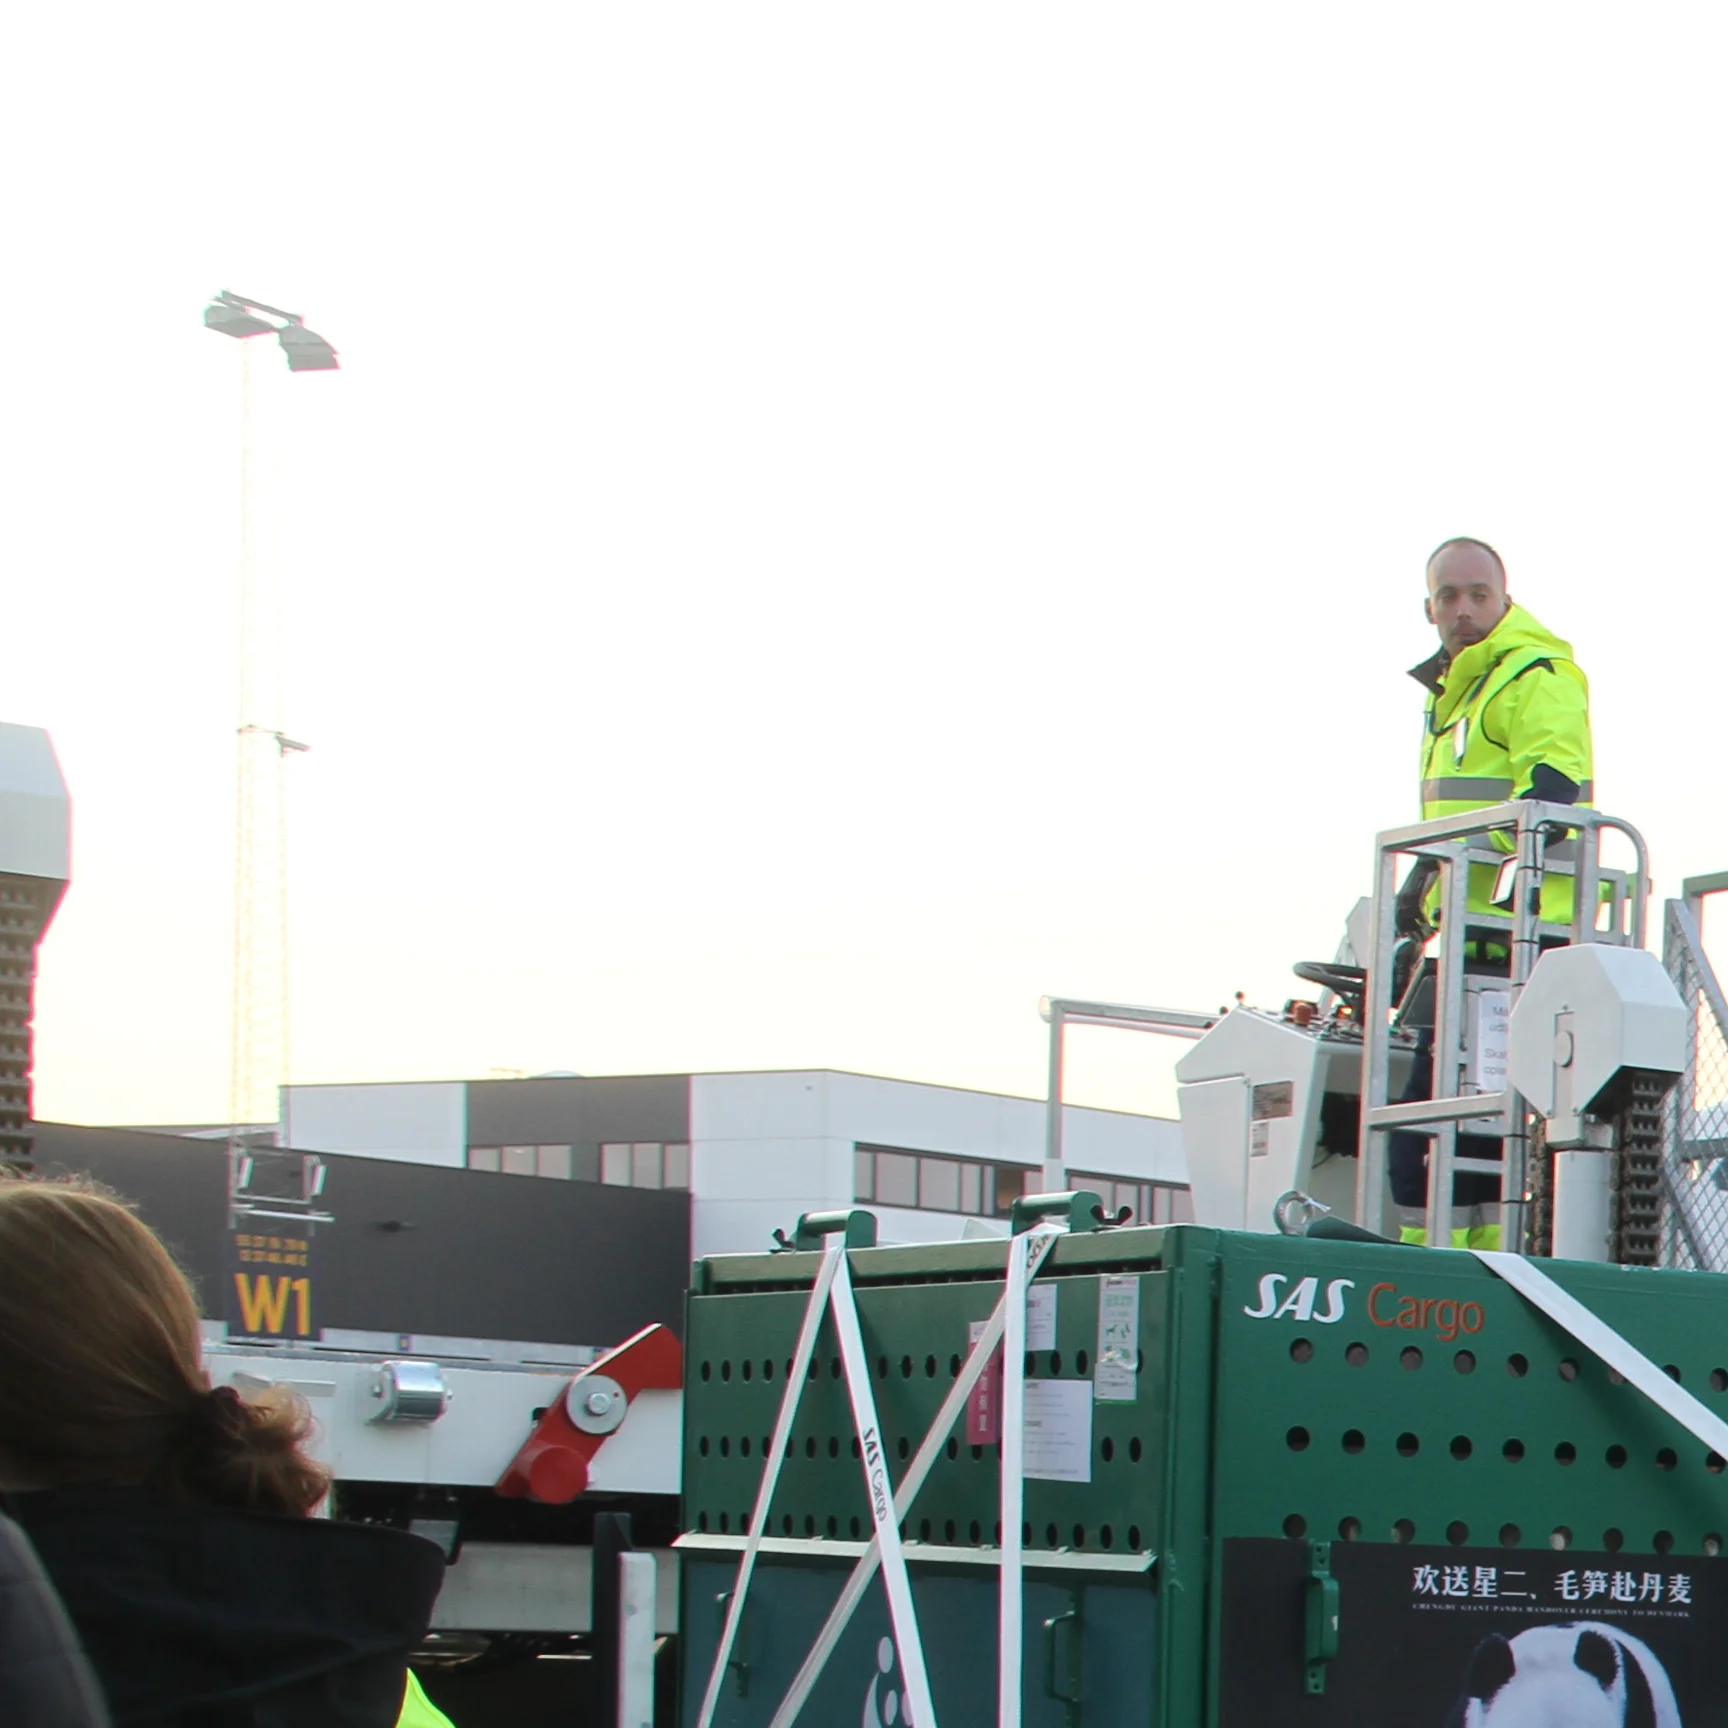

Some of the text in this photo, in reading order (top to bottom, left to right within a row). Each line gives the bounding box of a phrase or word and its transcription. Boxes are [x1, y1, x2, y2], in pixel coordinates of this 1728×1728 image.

[233, 1271, 311, 1336] W1
[1244, 1273, 1485, 1341] SAS Cargo
[862, 1426, 888, 1522] SAS Cargo
[1412, 1565, 1692, 1604] 欢送星二、毛笋赴丹麦
